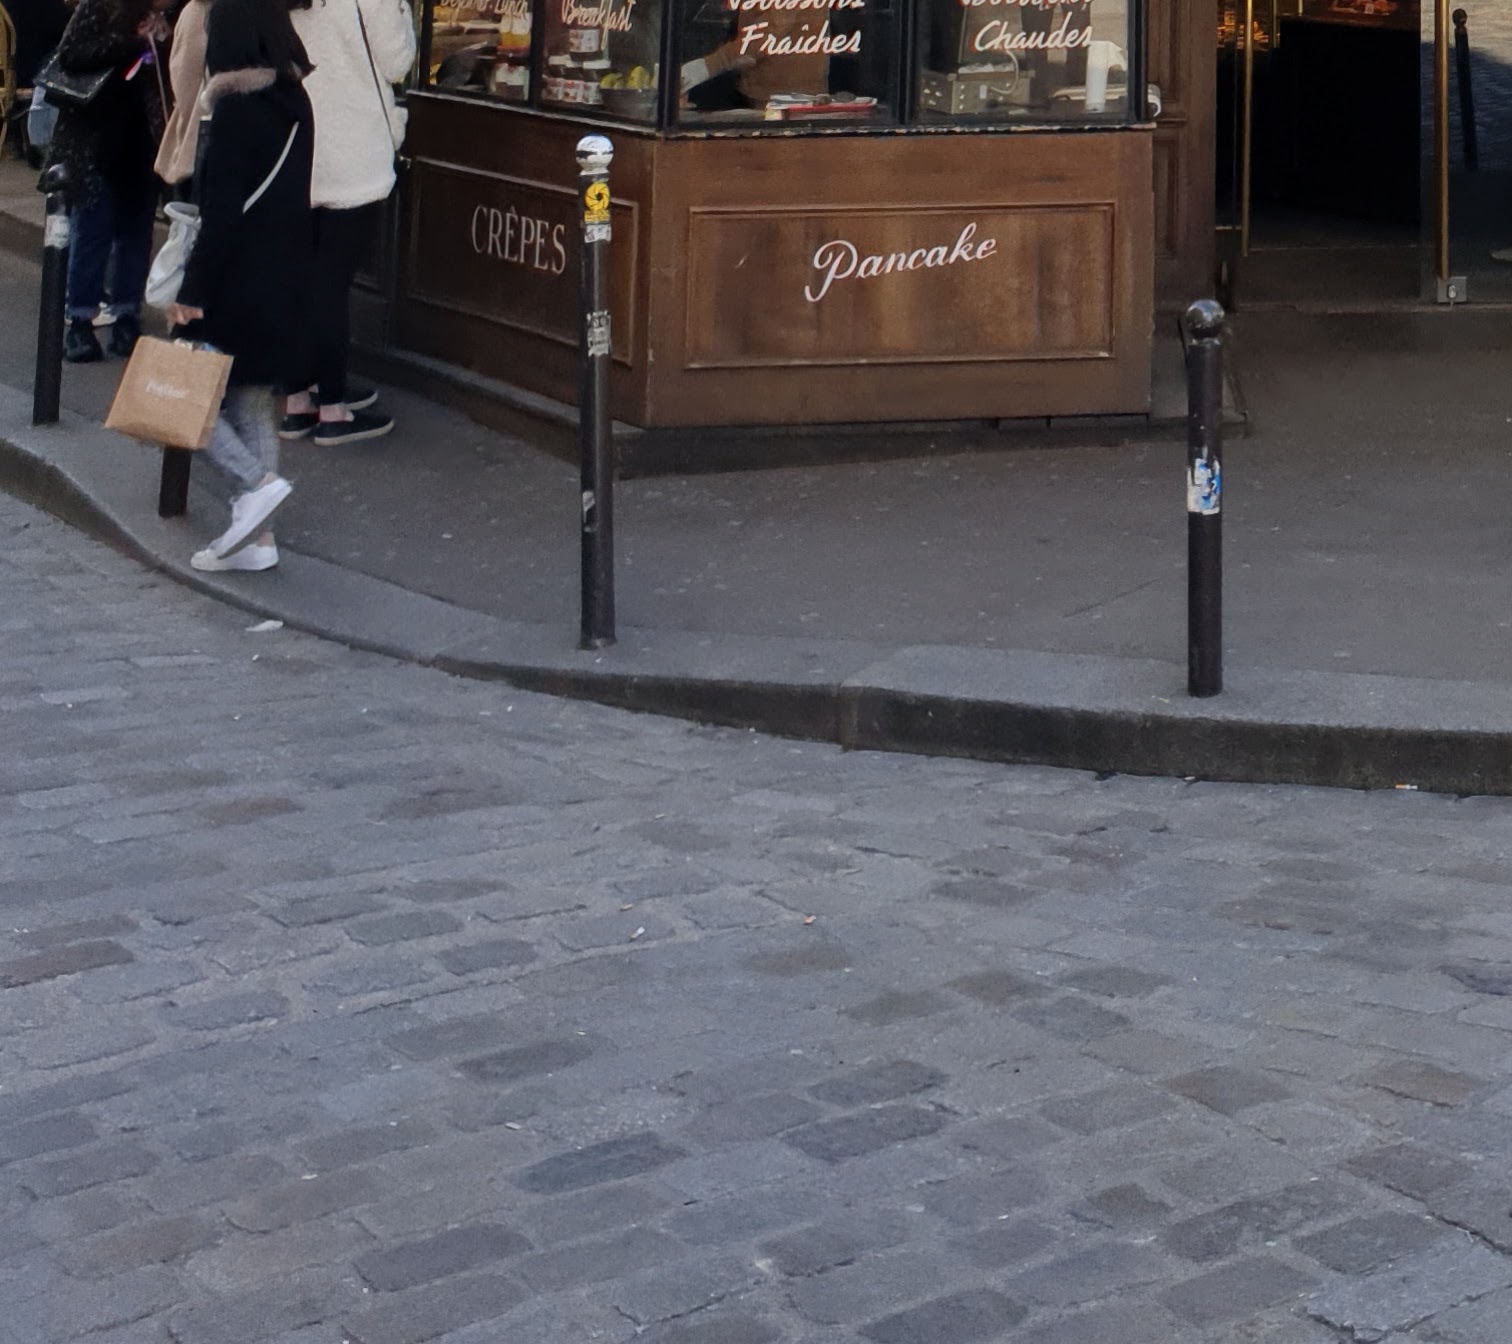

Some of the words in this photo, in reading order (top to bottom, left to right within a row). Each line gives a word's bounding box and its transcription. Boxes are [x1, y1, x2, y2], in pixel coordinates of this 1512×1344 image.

[739, 20, 862, 55] Fraîches
[972, 11, 1094, 50] Chaudes
[471, 202, 568, 277] CRÊPES
[803, 221, 997, 303] Pancake
